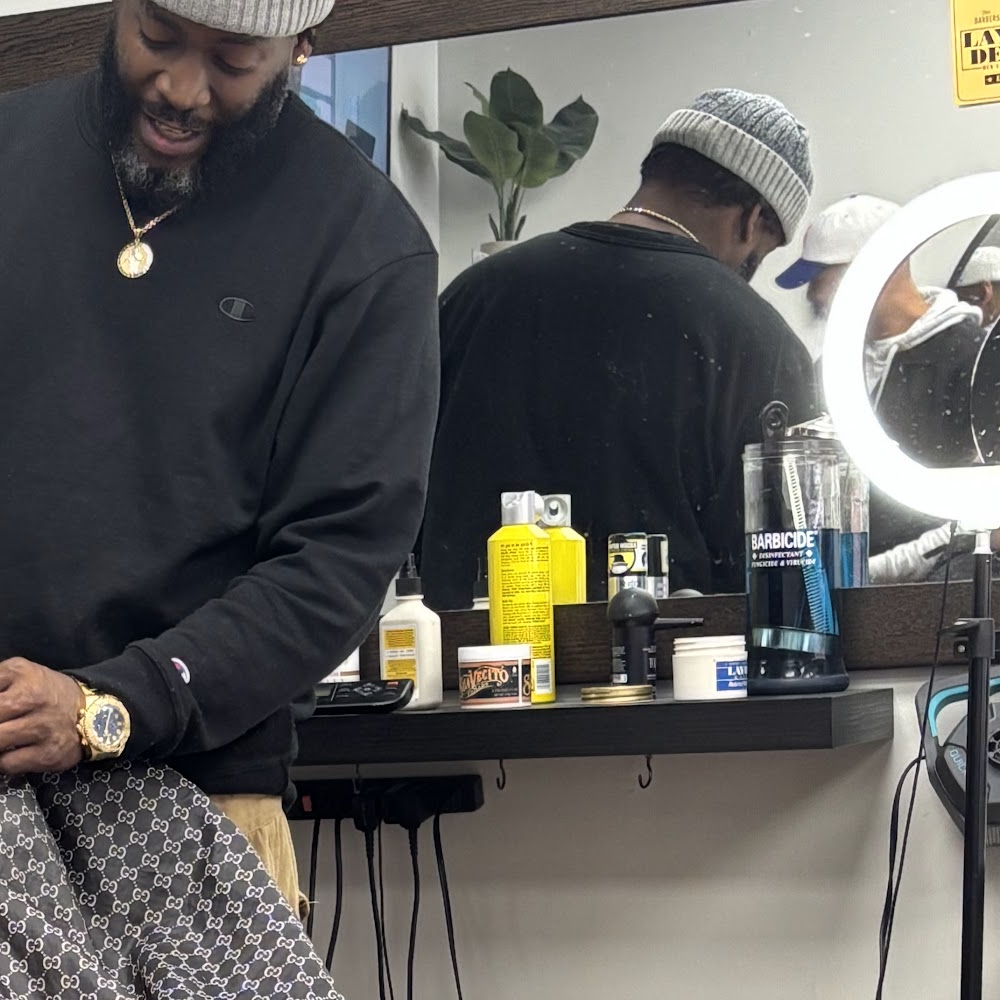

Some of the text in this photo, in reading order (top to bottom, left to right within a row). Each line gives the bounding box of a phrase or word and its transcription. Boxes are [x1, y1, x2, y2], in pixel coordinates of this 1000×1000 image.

[751, 530, 815, 550] BARBICIDE
[759, 551, 803, 559] DISINFECTANT
[949, 749, 967, 775] QUIC
